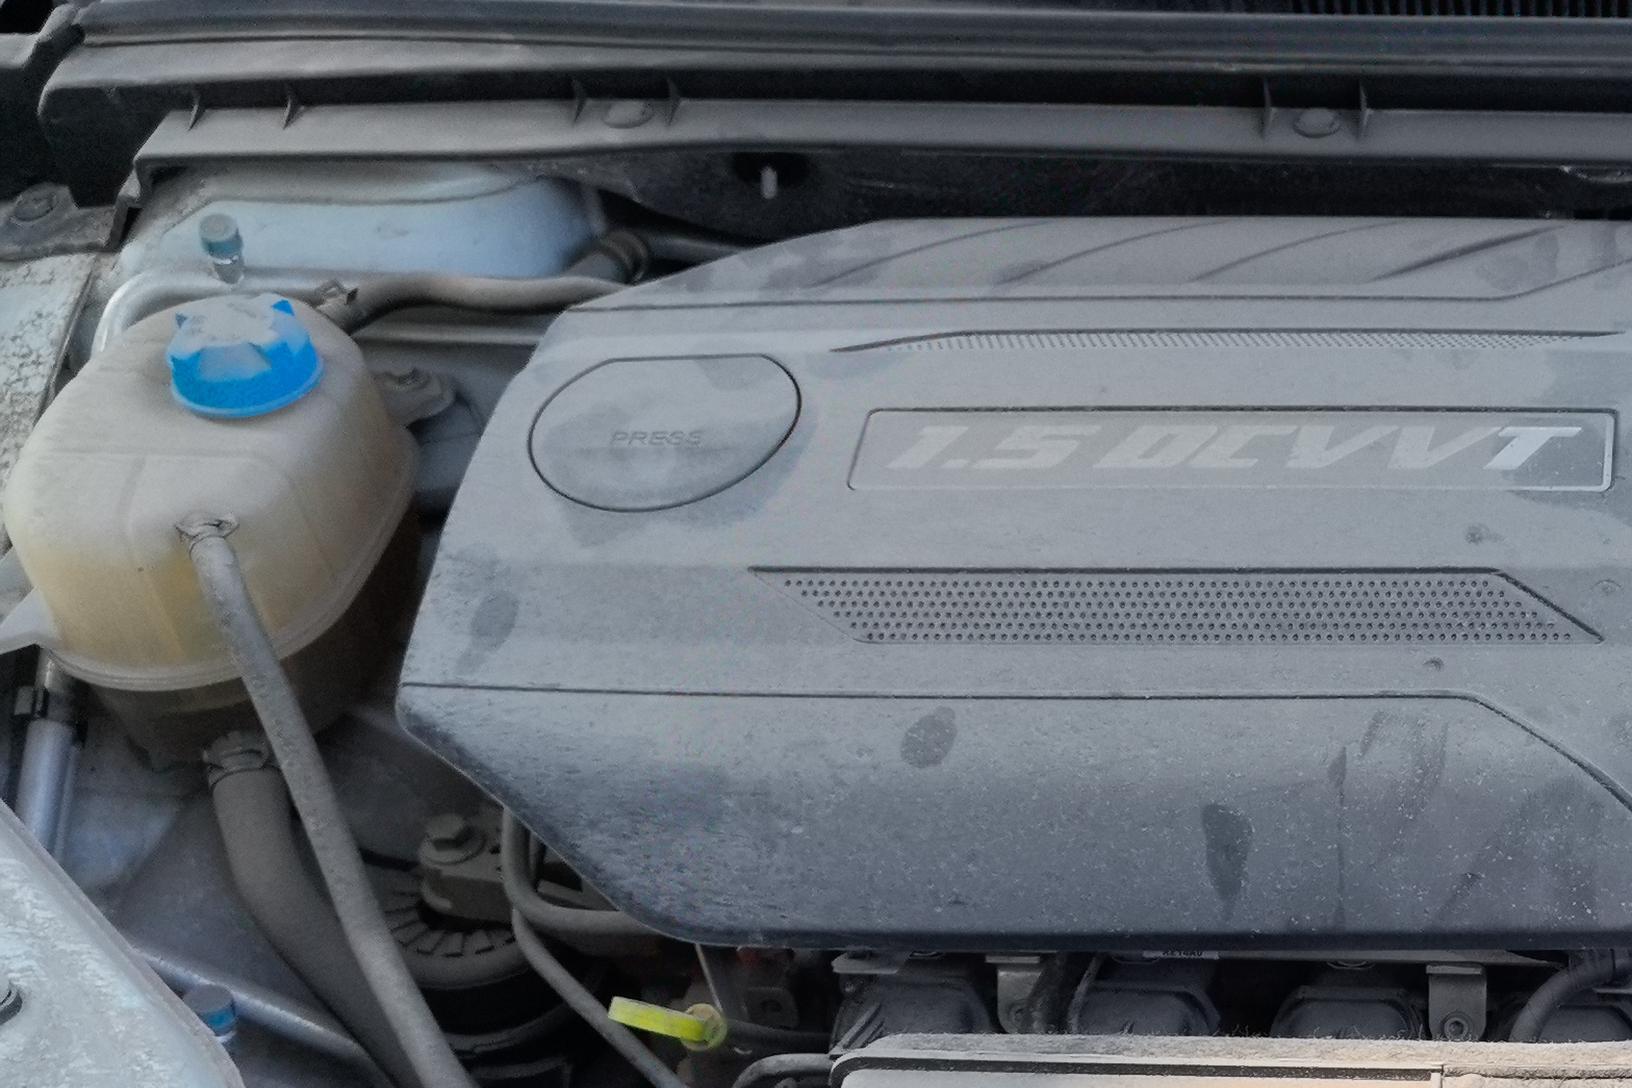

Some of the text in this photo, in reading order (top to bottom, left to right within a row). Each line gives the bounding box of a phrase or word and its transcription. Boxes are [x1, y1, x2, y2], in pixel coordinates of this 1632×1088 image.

[610, 429, 703, 447] PRESS
[888, 424, 1583, 470] 1.5 DCVVT
